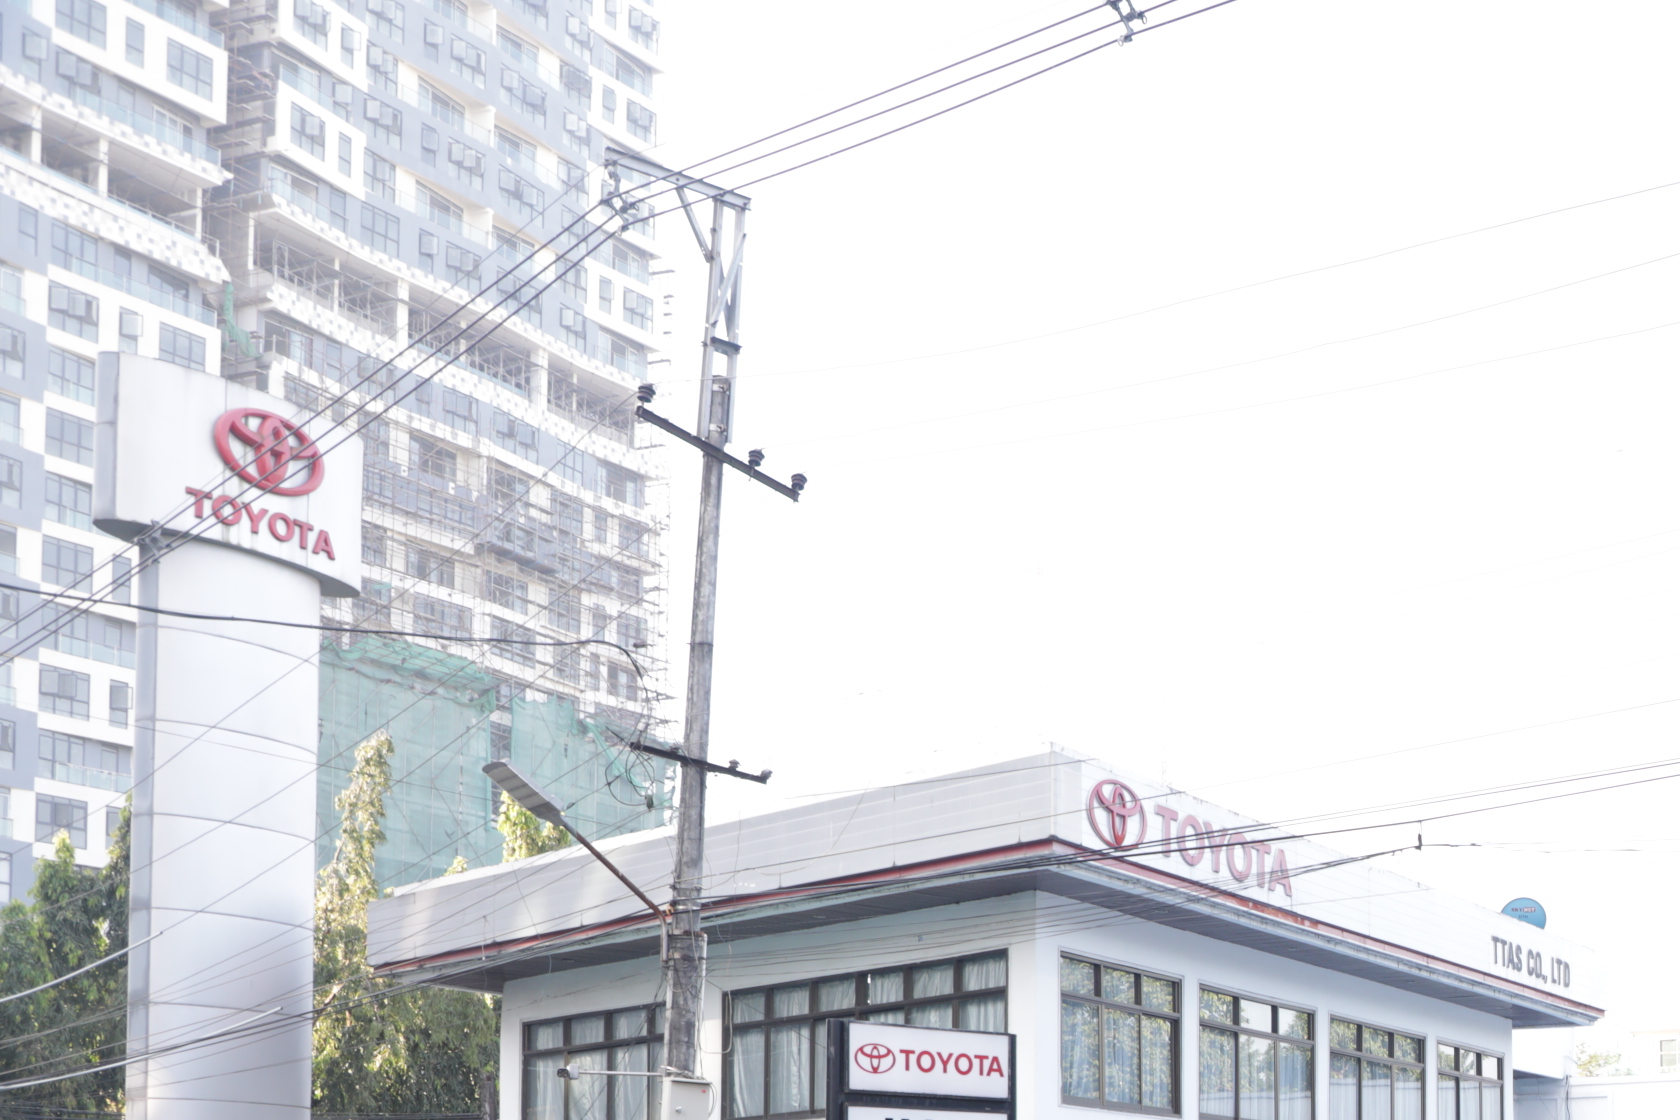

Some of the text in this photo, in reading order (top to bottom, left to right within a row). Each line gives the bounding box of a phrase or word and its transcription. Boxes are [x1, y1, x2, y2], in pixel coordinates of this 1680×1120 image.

[185, 486, 335, 561] TOYOTA
[1154, 803, 1293, 898] TOYOTA
[1491, 935, 1523, 973] TTAS
[1551, 956, 1571, 989] LTD
[899, 1048, 1005, 1078] TOYOTA
